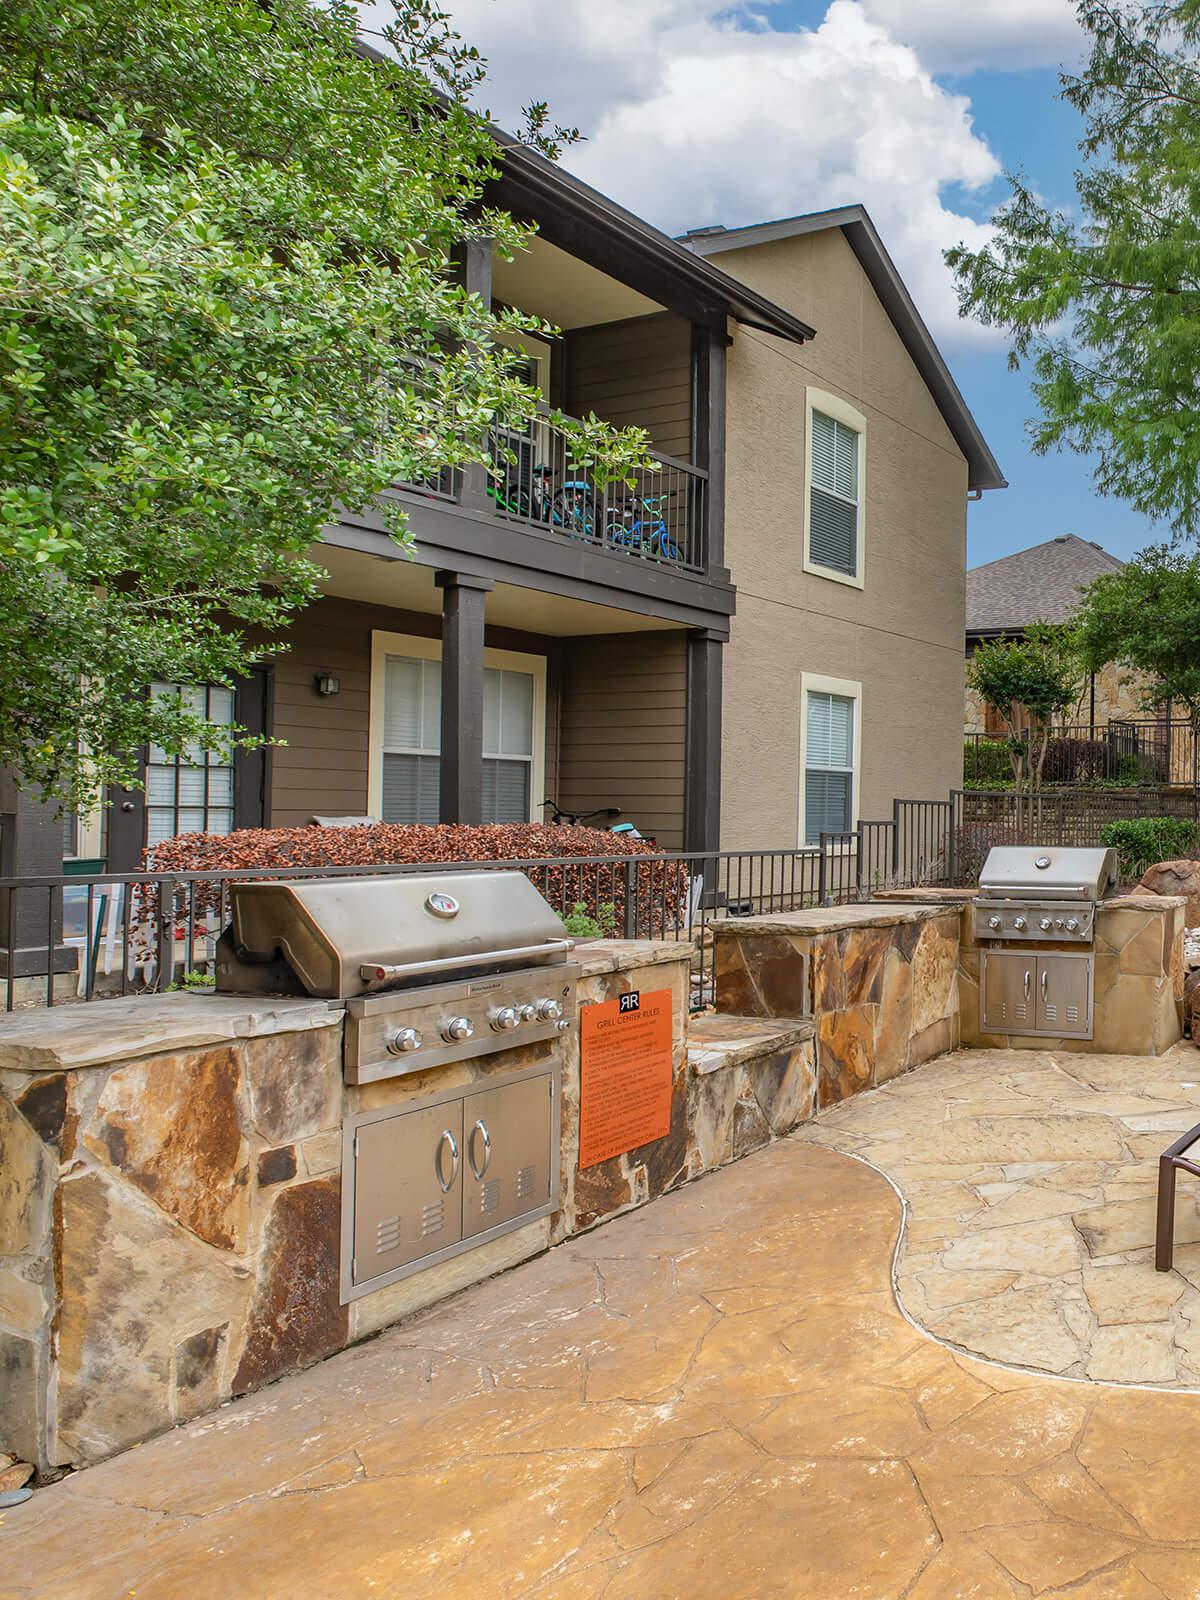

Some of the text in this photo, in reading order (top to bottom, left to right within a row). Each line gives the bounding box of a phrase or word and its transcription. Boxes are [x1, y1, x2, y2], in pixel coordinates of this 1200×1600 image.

[597, 1007, 660, 1030] GRILL CENTER RULES
